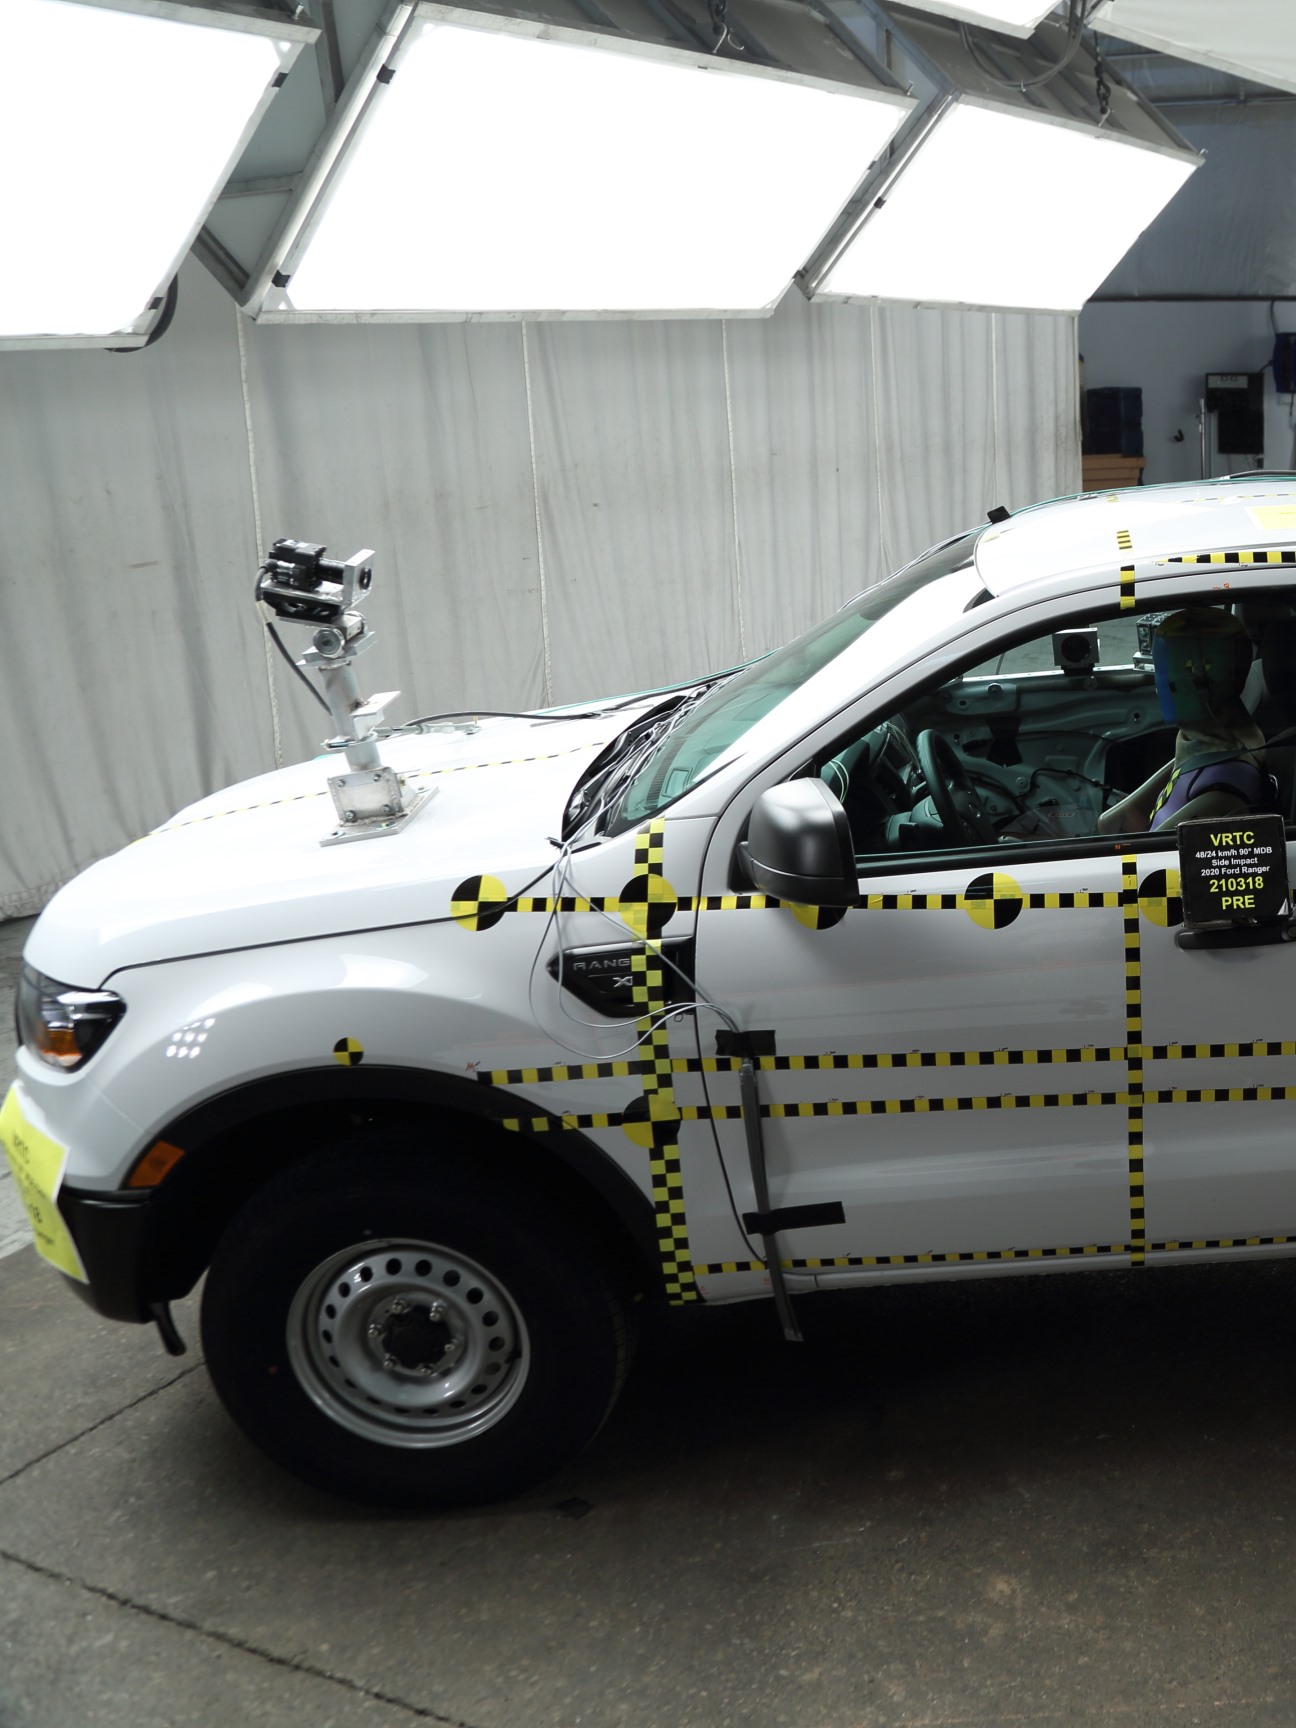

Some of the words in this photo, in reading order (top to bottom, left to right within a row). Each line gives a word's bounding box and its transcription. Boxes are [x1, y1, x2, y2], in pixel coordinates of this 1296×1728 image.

[1210, 831, 1255, 846] VRTC
[1195, 851, 1216, 859] 48/24
[1218, 849, 1237, 857] km/h
[1254, 846, 1272, 855] MDB
[1231, 857, 1258, 866] Impact
[1222, 867, 1240, 875] Ford
[1242, 866, 1270, 875] Ranger
[1210, 876, 1264, 893] 210318
[1221, 895, 1255, 910] PRE
[573, 958, 630, 971] RANG
